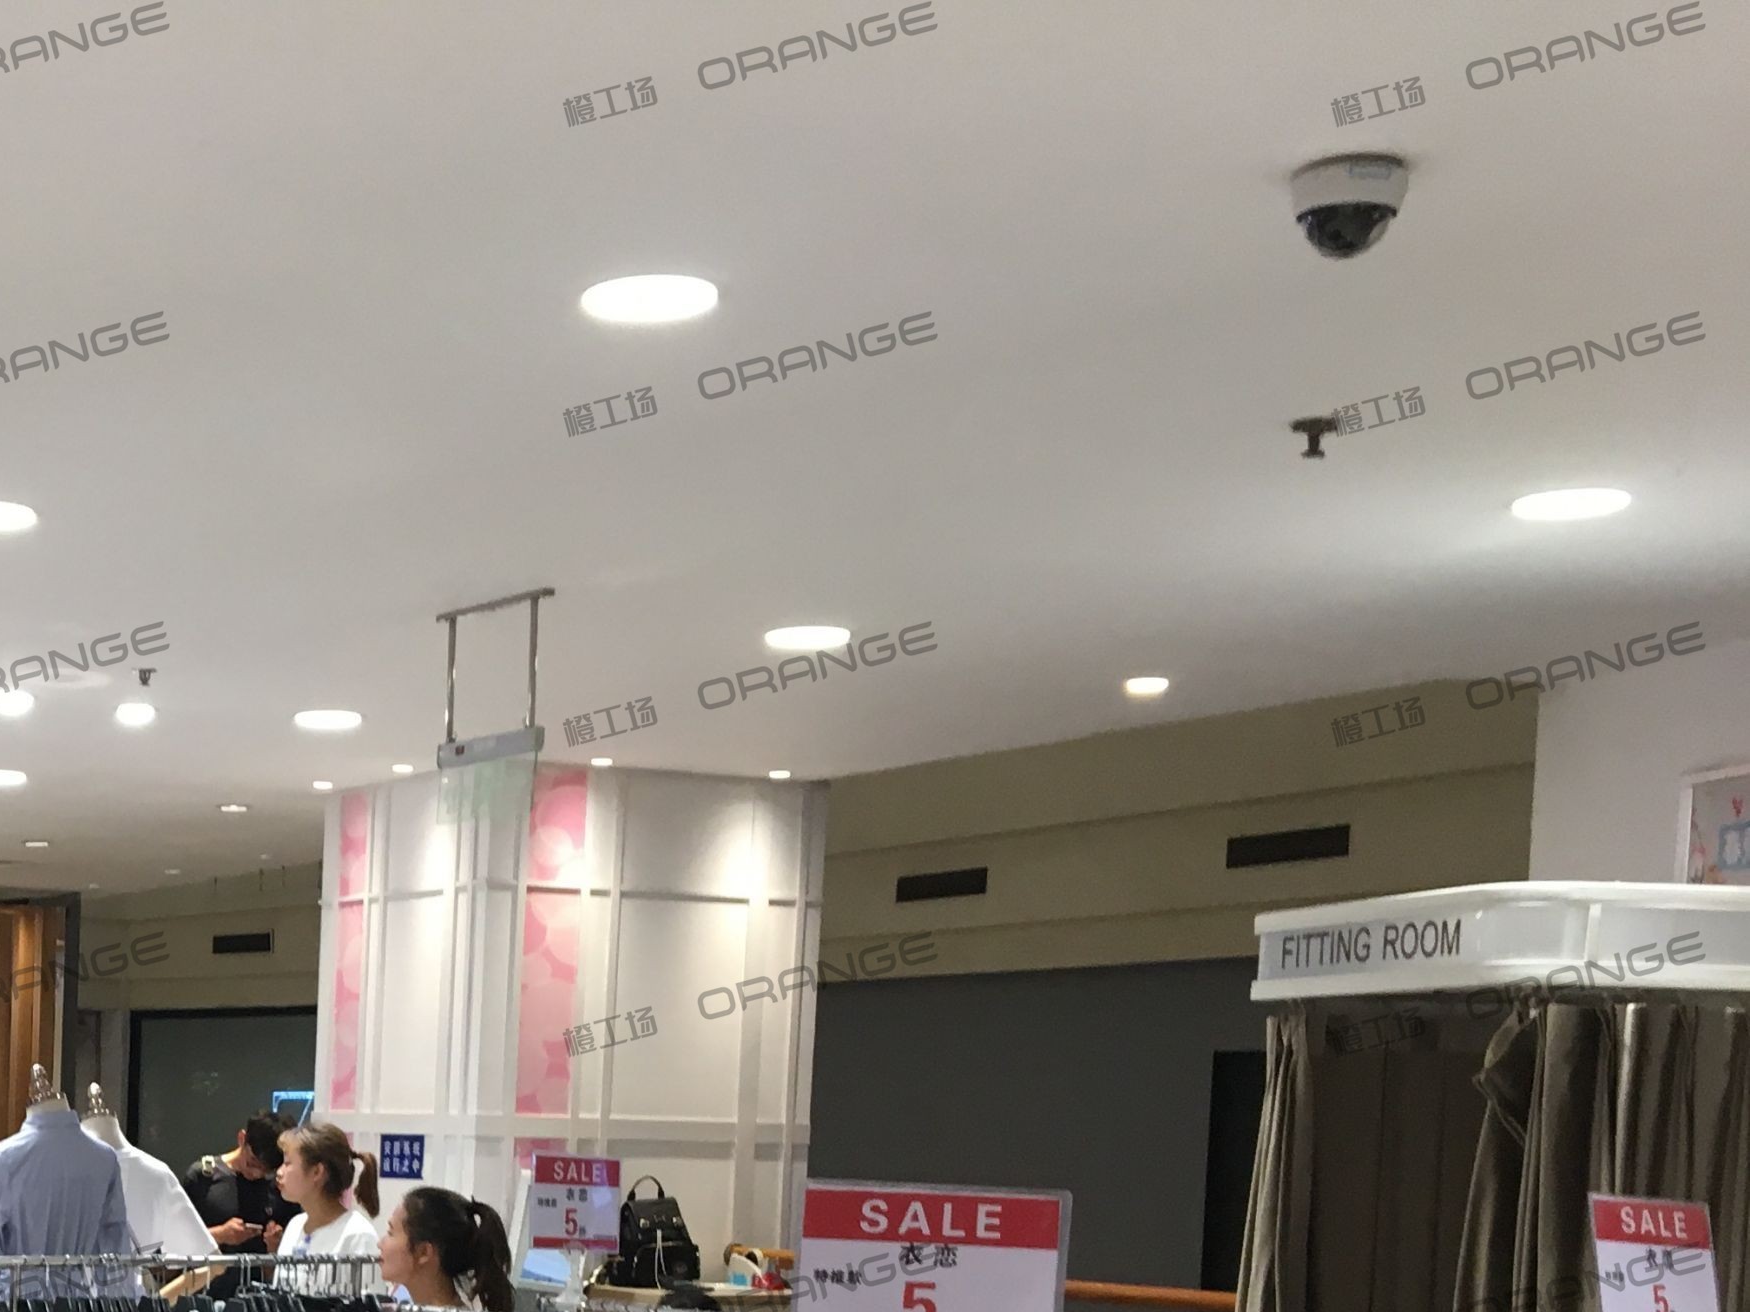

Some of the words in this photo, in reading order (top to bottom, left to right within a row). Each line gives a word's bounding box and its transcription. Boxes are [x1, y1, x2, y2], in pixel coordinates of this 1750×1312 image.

[1281, 926, 1371, 969] FITTING
[1382, 918, 1461, 960] ROOM
[553, 1159, 603, 1183] SALE
[860, 1198, 1002, 1240] SALE
[1620, 1205, 1687, 1240] SALE
[898, 1241, 958, 1267] 衣恋
